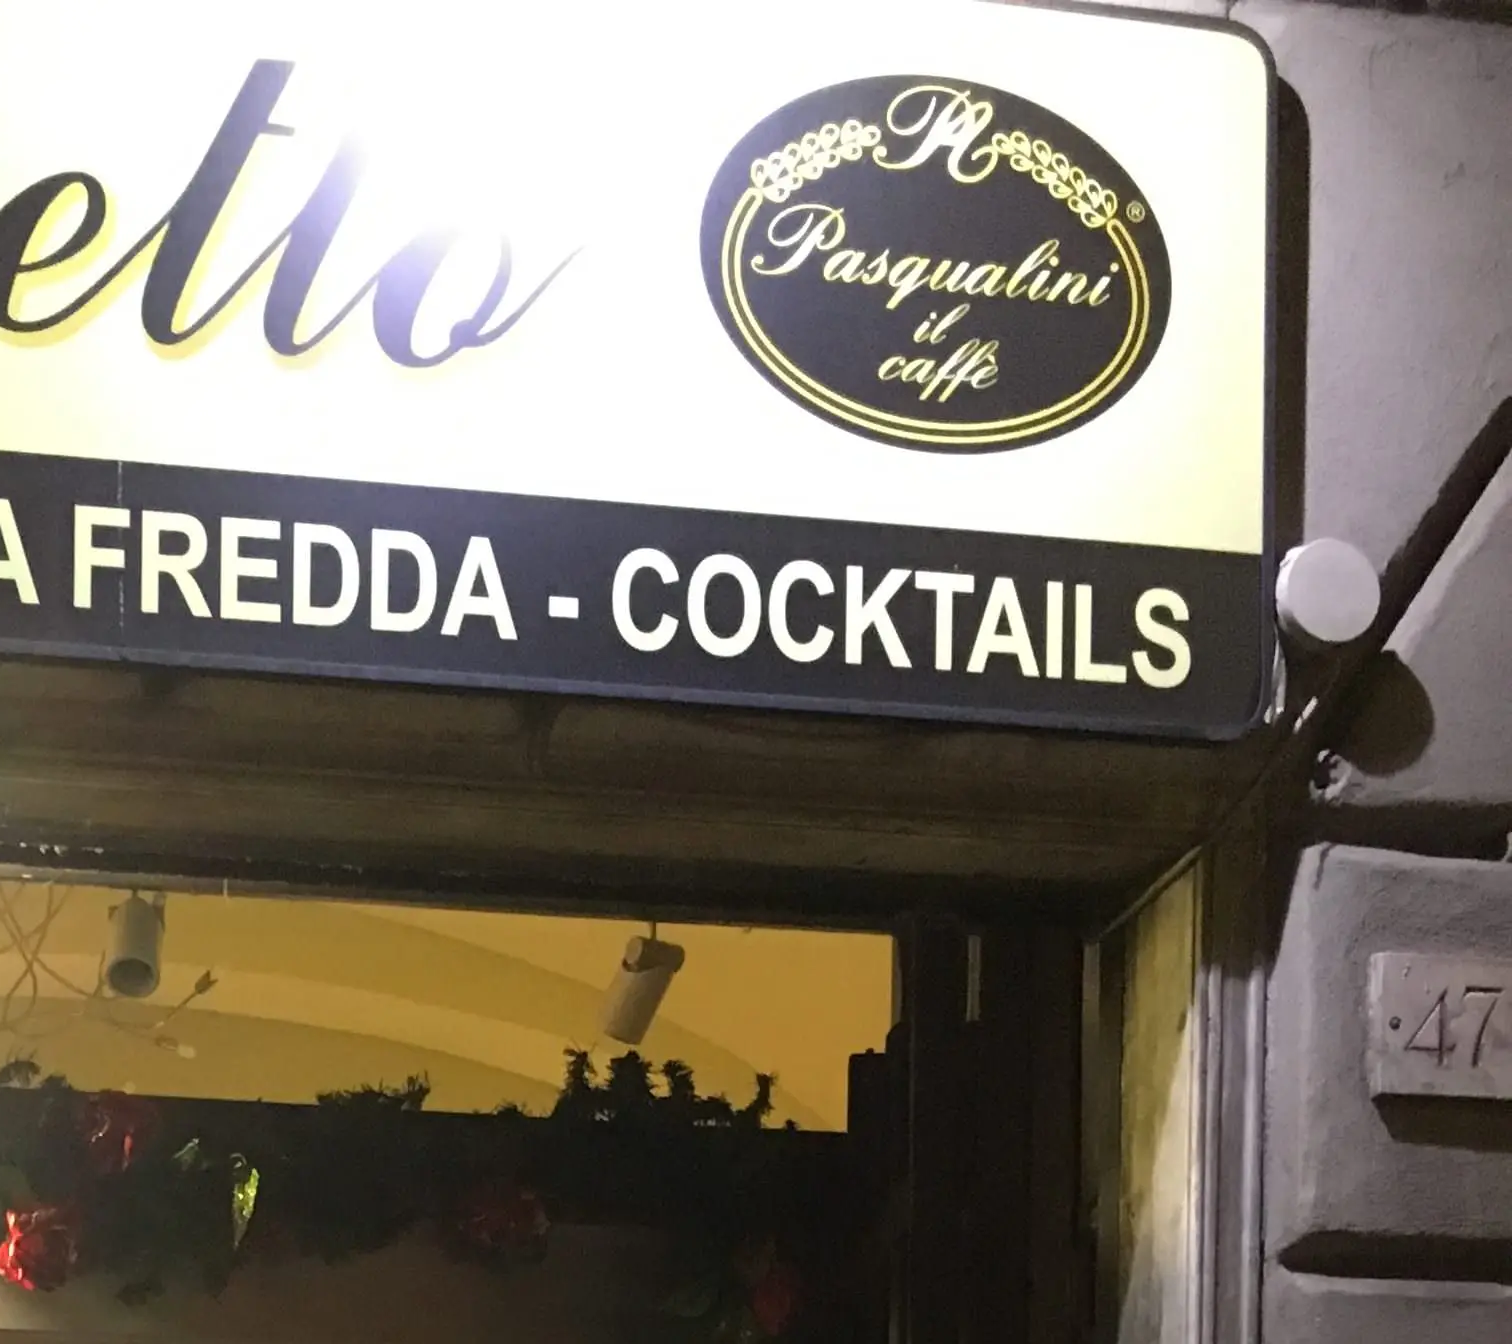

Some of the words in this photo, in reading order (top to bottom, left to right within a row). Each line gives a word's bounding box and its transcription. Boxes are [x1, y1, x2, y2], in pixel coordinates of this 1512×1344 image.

[750, 203, 1120, 309] Pasqualini
[913, 303, 970, 344] il
[878, 338, 1000, 403] caffè
[74, 506, 516, 640] FREDDA
[612, 546, 1193, 689] COCKTAILS
[1404, 986, 1505, 1069] 47
